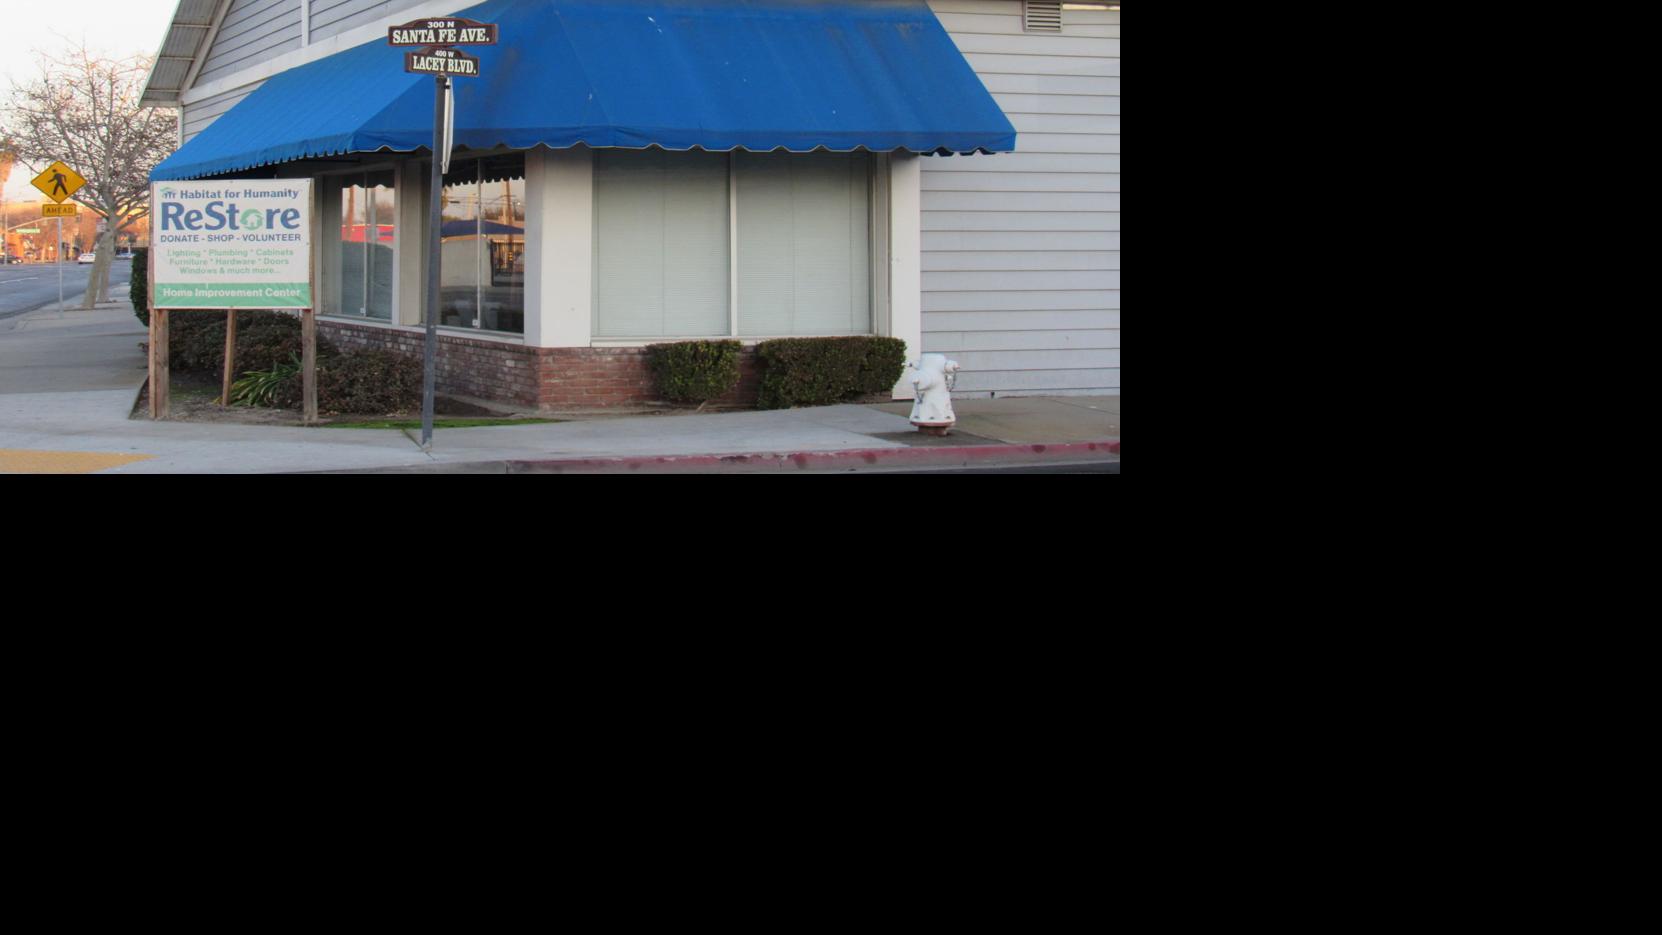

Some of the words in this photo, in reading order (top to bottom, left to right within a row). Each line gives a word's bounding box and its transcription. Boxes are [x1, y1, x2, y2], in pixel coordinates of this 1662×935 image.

[427, 21, 444, 29] 300
[392, 29, 435, 44] SANTA
[438, 29, 456, 42] FE
[459, 28, 490, 42] AVE.
[413, 55, 446, 72] LACEY
[447, 59, 477, 74] BLVD.
[180, 189, 221, 199] Habitat
[224, 188, 241, 199] for
[244, 188, 299, 200] Humanity
[161, 201, 300, 231] ReStore
[160, 234, 199, 243] DONATE
[207, 234, 234, 242] SHOP
[242, 233, 301, 242] VOLUNTEER
[167, 249, 201, 258] Lighting
[208, 249, 249, 257] Plumbing
[163, 287, 193, 297] Home
[195, 287, 263, 298] Improvement
[265, 287, 301, 297] Center
